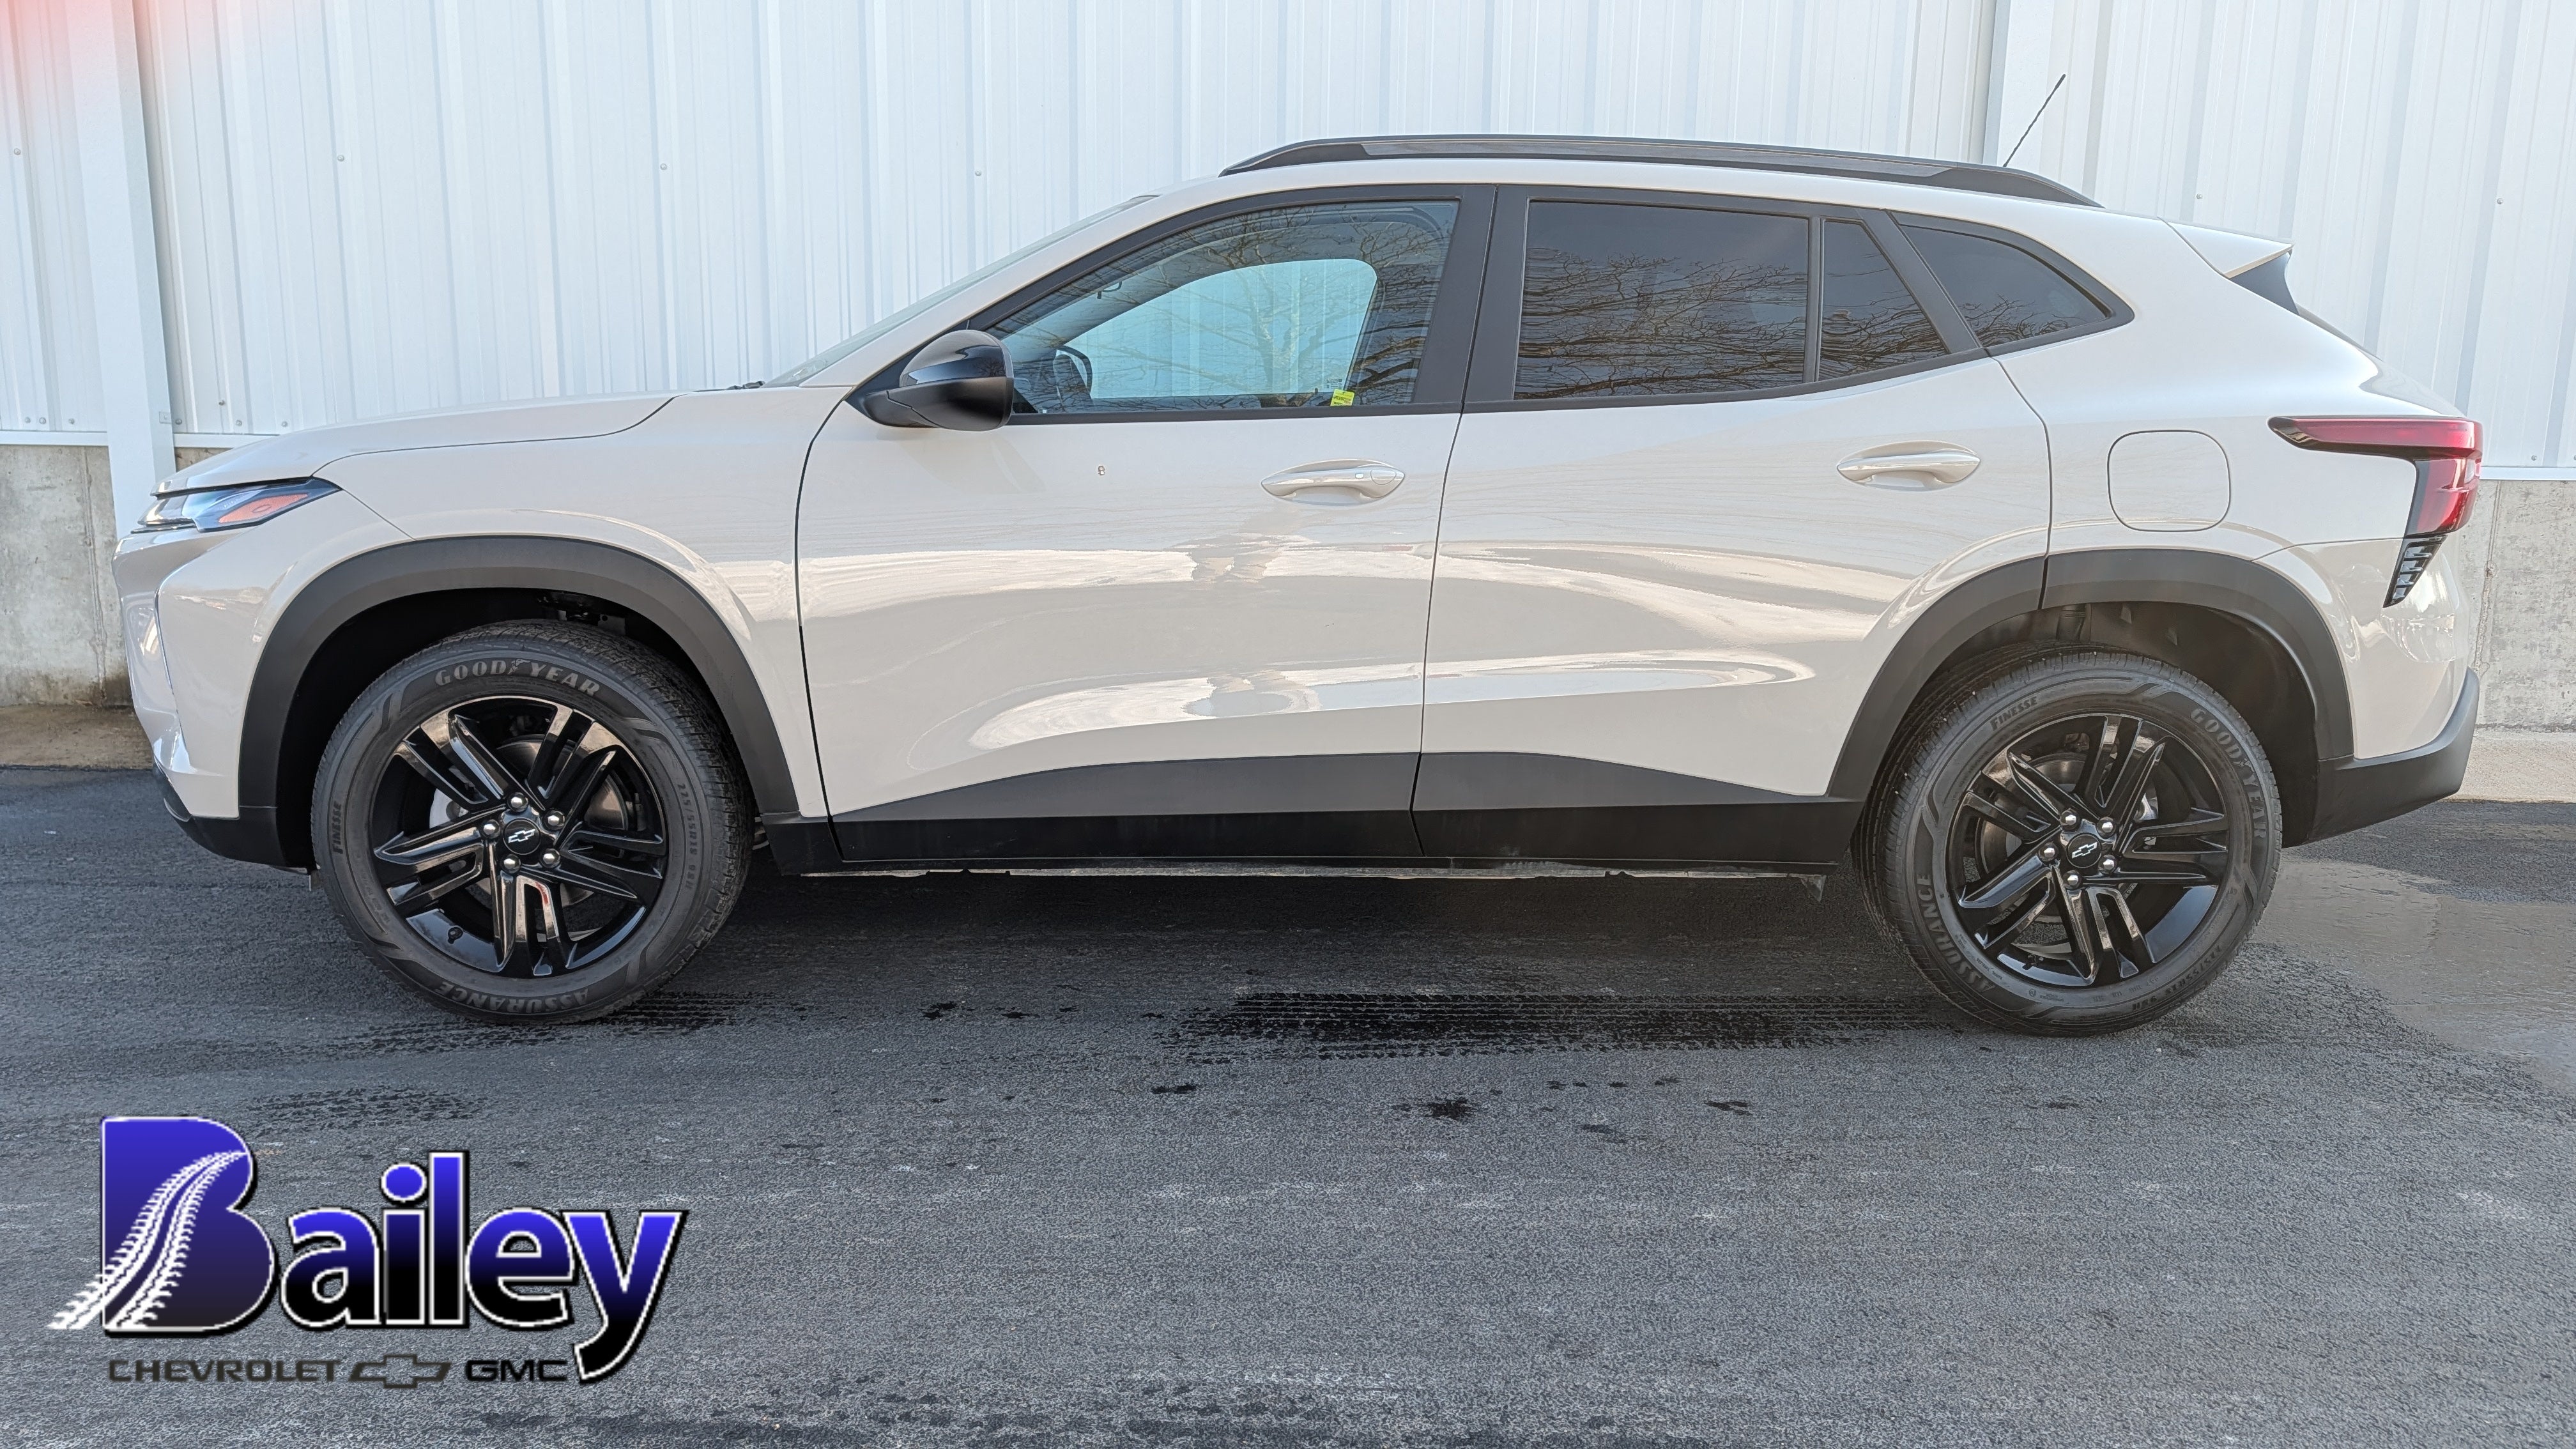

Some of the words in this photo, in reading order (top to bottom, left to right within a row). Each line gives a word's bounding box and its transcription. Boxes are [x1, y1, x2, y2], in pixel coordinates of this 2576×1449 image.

[1989, 696, 2038, 732] FINESSE
[332, 800, 344, 855] FINESSE
[1917, 873, 1996, 991] ASSURANCE
[436, 981, 588, 1013] ASSURANCE
